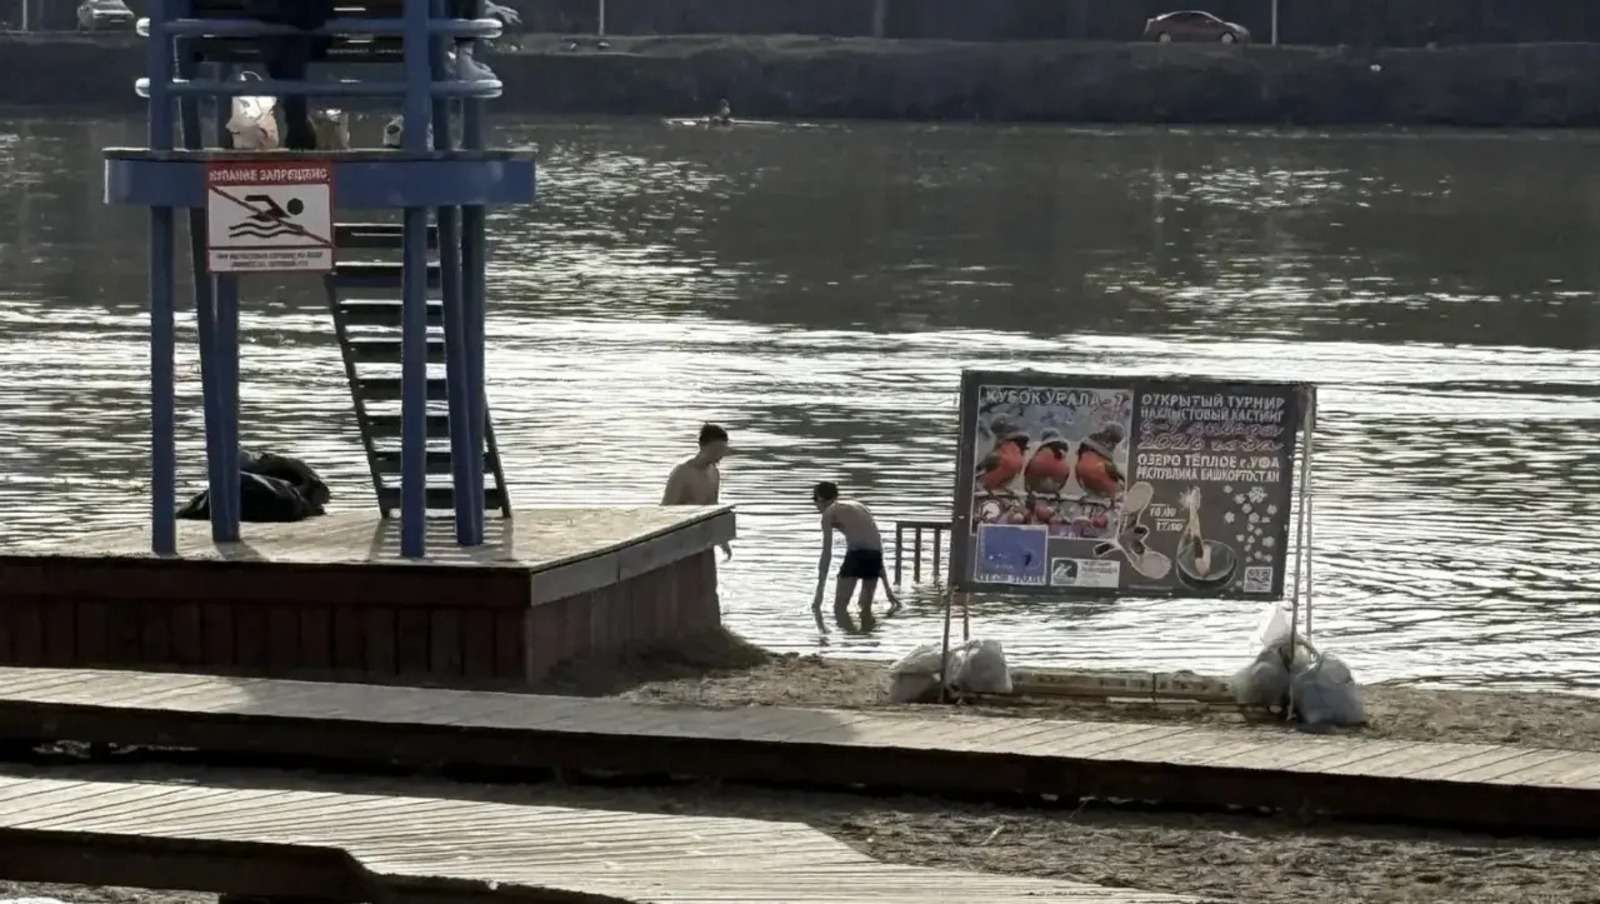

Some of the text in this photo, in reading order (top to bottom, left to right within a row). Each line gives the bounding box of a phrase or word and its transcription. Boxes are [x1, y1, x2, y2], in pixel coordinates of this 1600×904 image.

[986, 390, 1041, 405] КУБОК
[1045, 391, 1100, 406] УРАЛА
[1141, 393, 1285, 410] ОТКРЫТЫЙ ТУРНИР
[1137, 453, 1181, 467] ОЗЕРО
